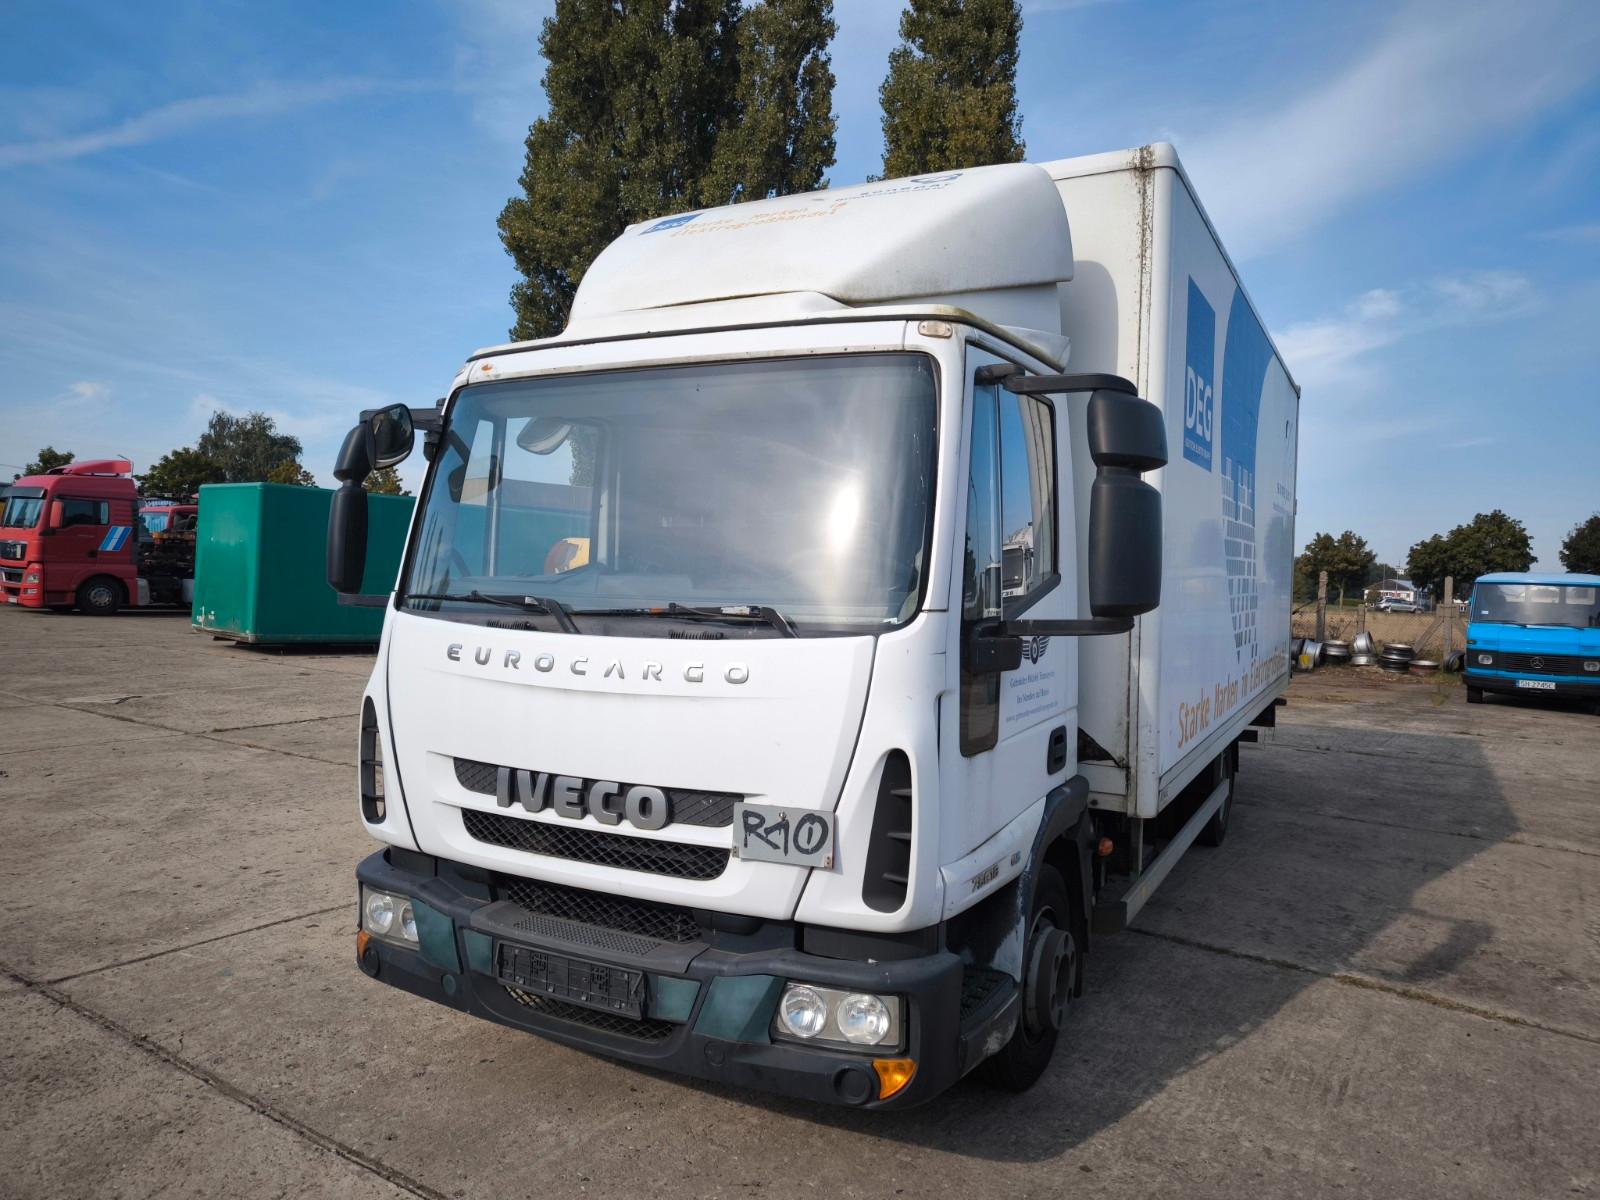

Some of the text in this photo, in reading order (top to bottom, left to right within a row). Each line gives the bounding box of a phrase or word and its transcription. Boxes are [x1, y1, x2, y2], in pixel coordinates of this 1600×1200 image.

[1186, 366, 1212, 442] DEG
[447, 643, 750, 685] EUROCARGO
[1179, 689, 1209, 748] Starke
[1215, 674, 1239, 718] Marken
[496, 766, 669, 830] IVECO
[742, 809, 830, 856] R10
